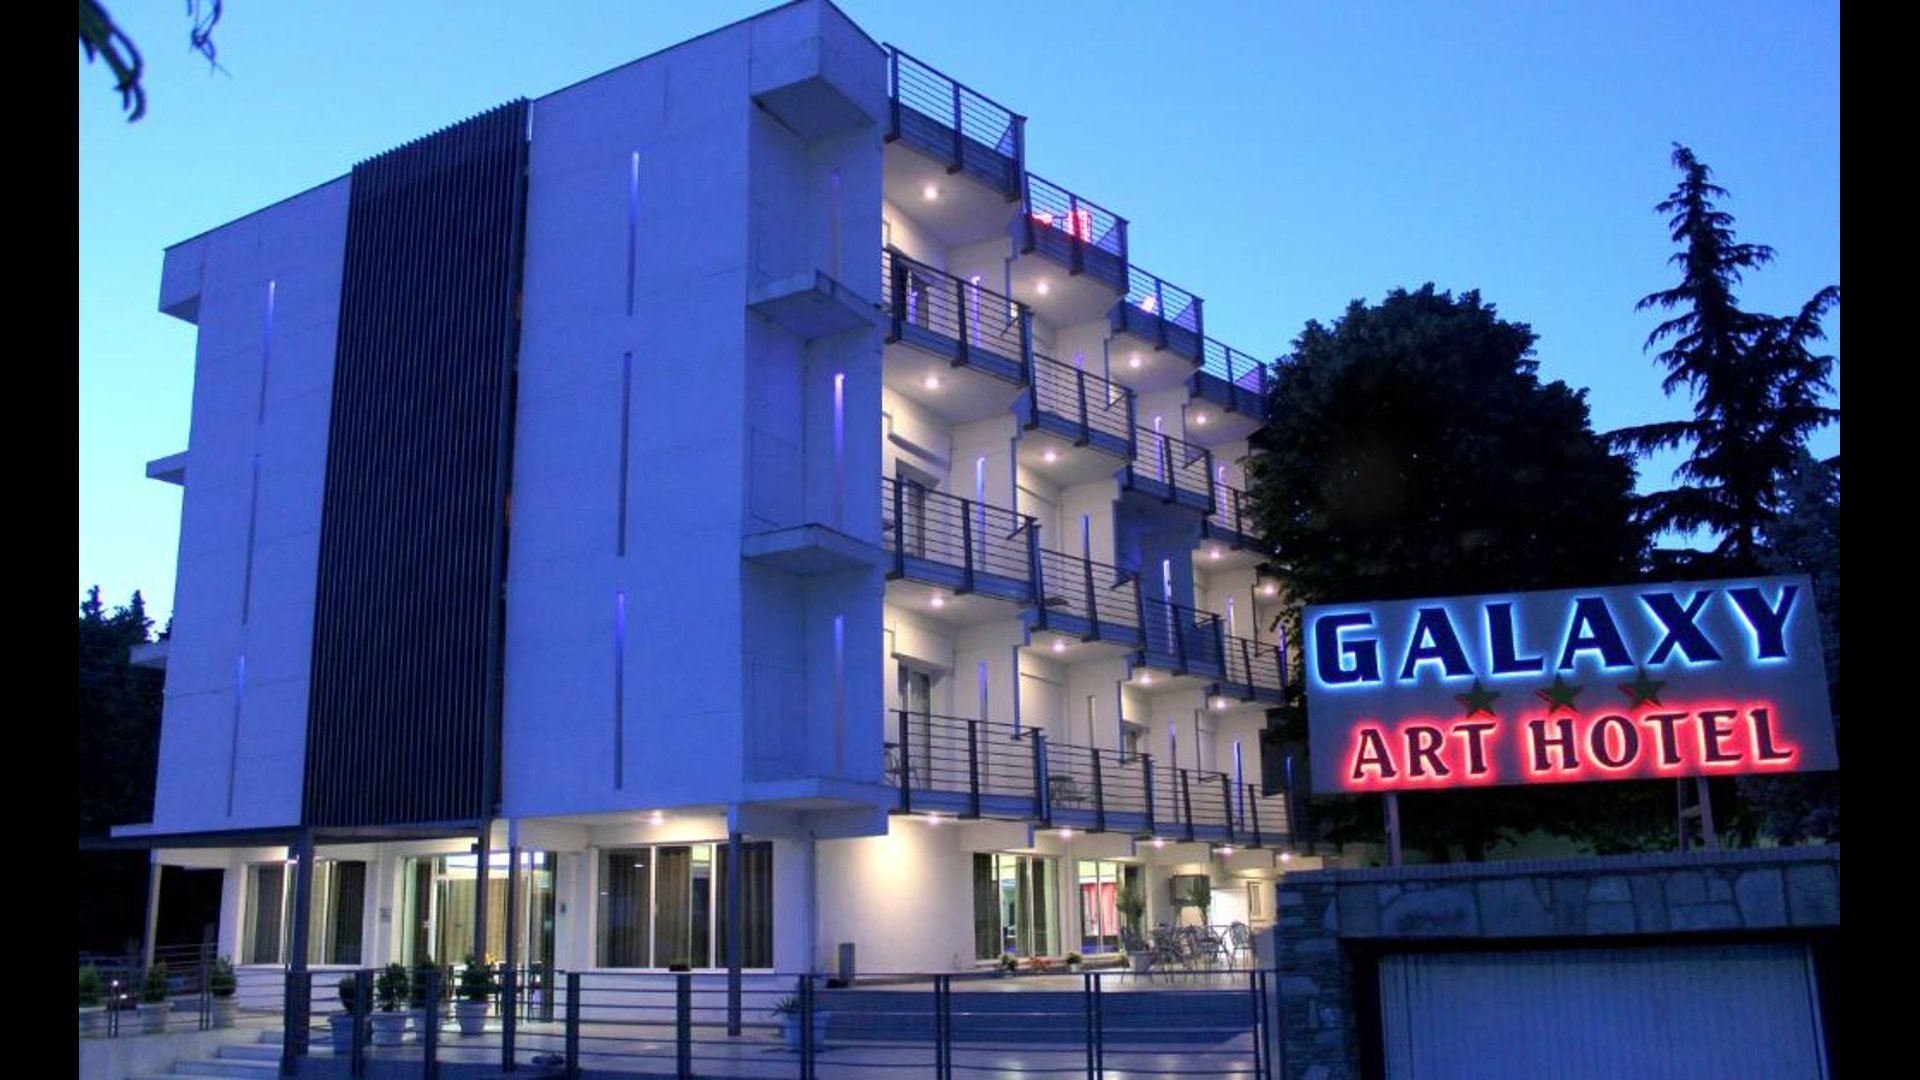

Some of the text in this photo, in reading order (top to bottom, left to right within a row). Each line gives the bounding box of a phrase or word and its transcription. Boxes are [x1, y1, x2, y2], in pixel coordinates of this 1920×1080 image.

[1314, 586, 1798, 685] GALAXY
[1352, 708, 1793, 780] ART HOTEL
